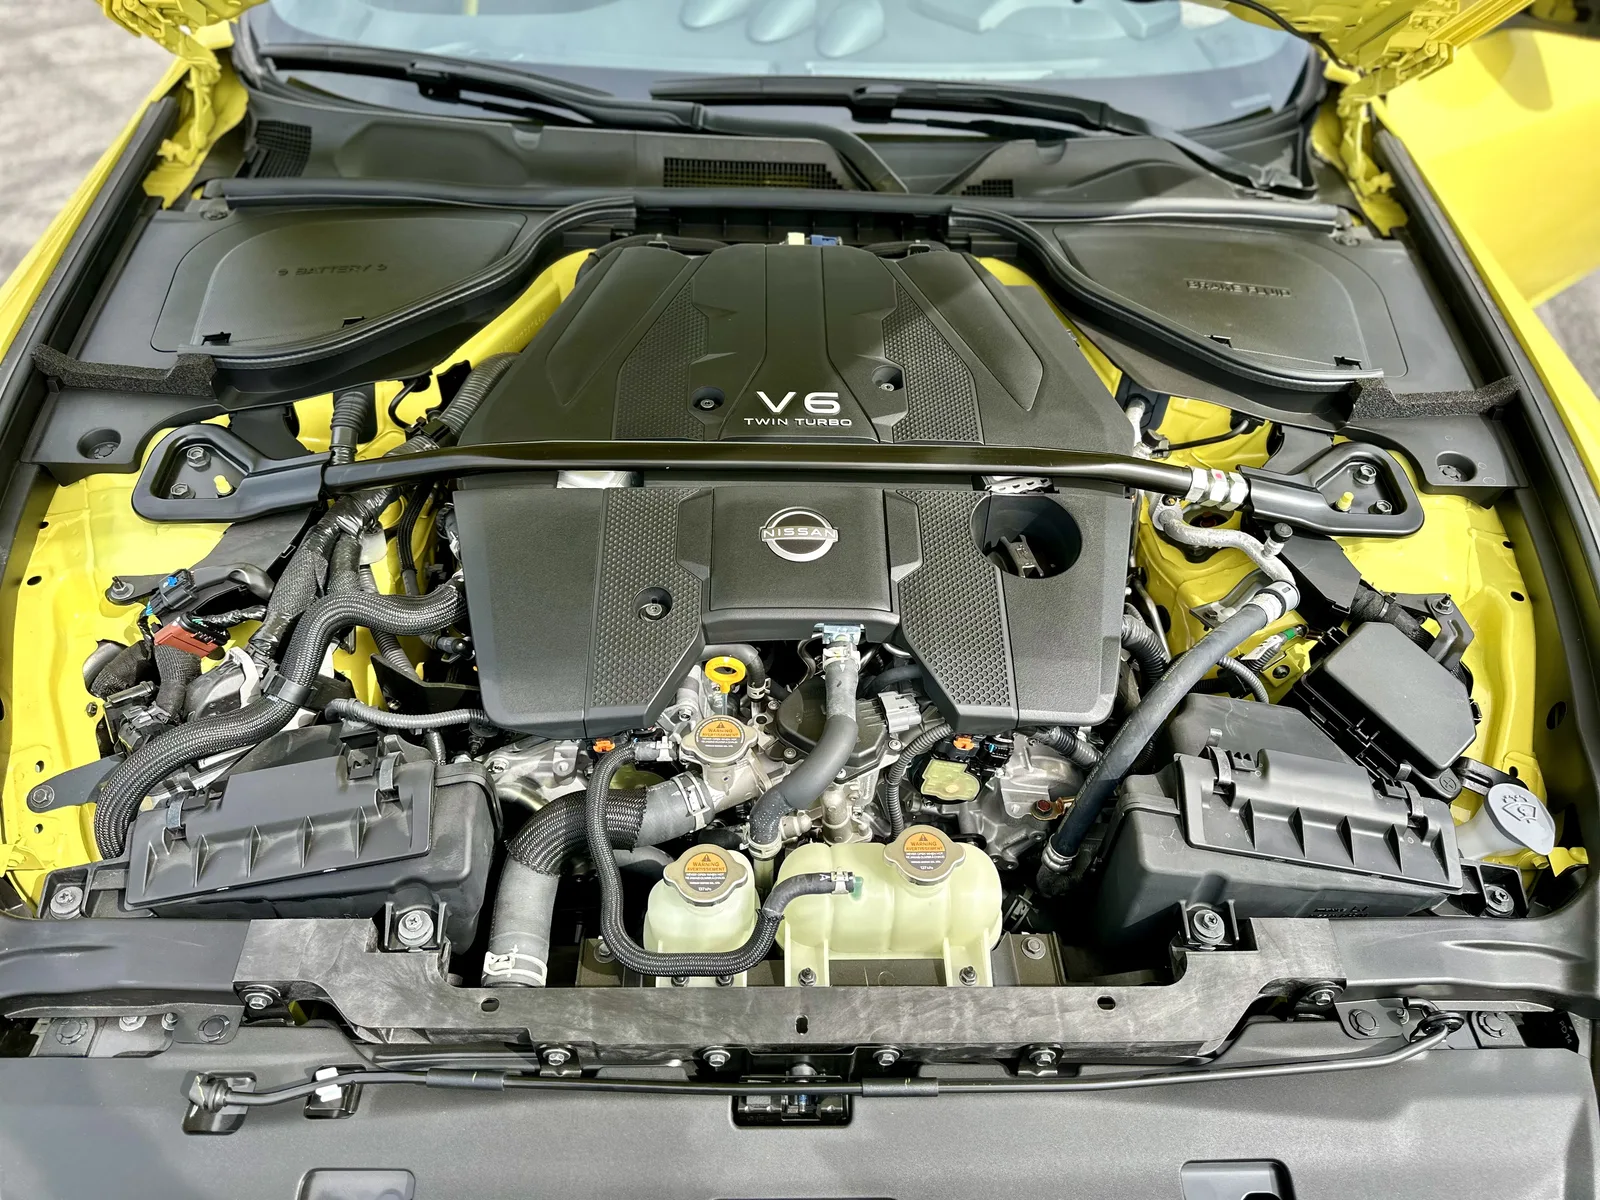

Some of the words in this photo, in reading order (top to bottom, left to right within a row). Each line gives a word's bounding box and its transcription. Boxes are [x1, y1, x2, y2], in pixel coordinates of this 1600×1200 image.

[295, 263, 372, 276] BATTERY
[1186, 280, 1243, 293] BRAKE
[1246, 285, 1292, 298] FLUID
[756, 391, 841, 416] V6
[744, 418, 788, 426] TWIN
[794, 418, 853, 427] TURBO
[763, 527, 837, 539] NISSAN
